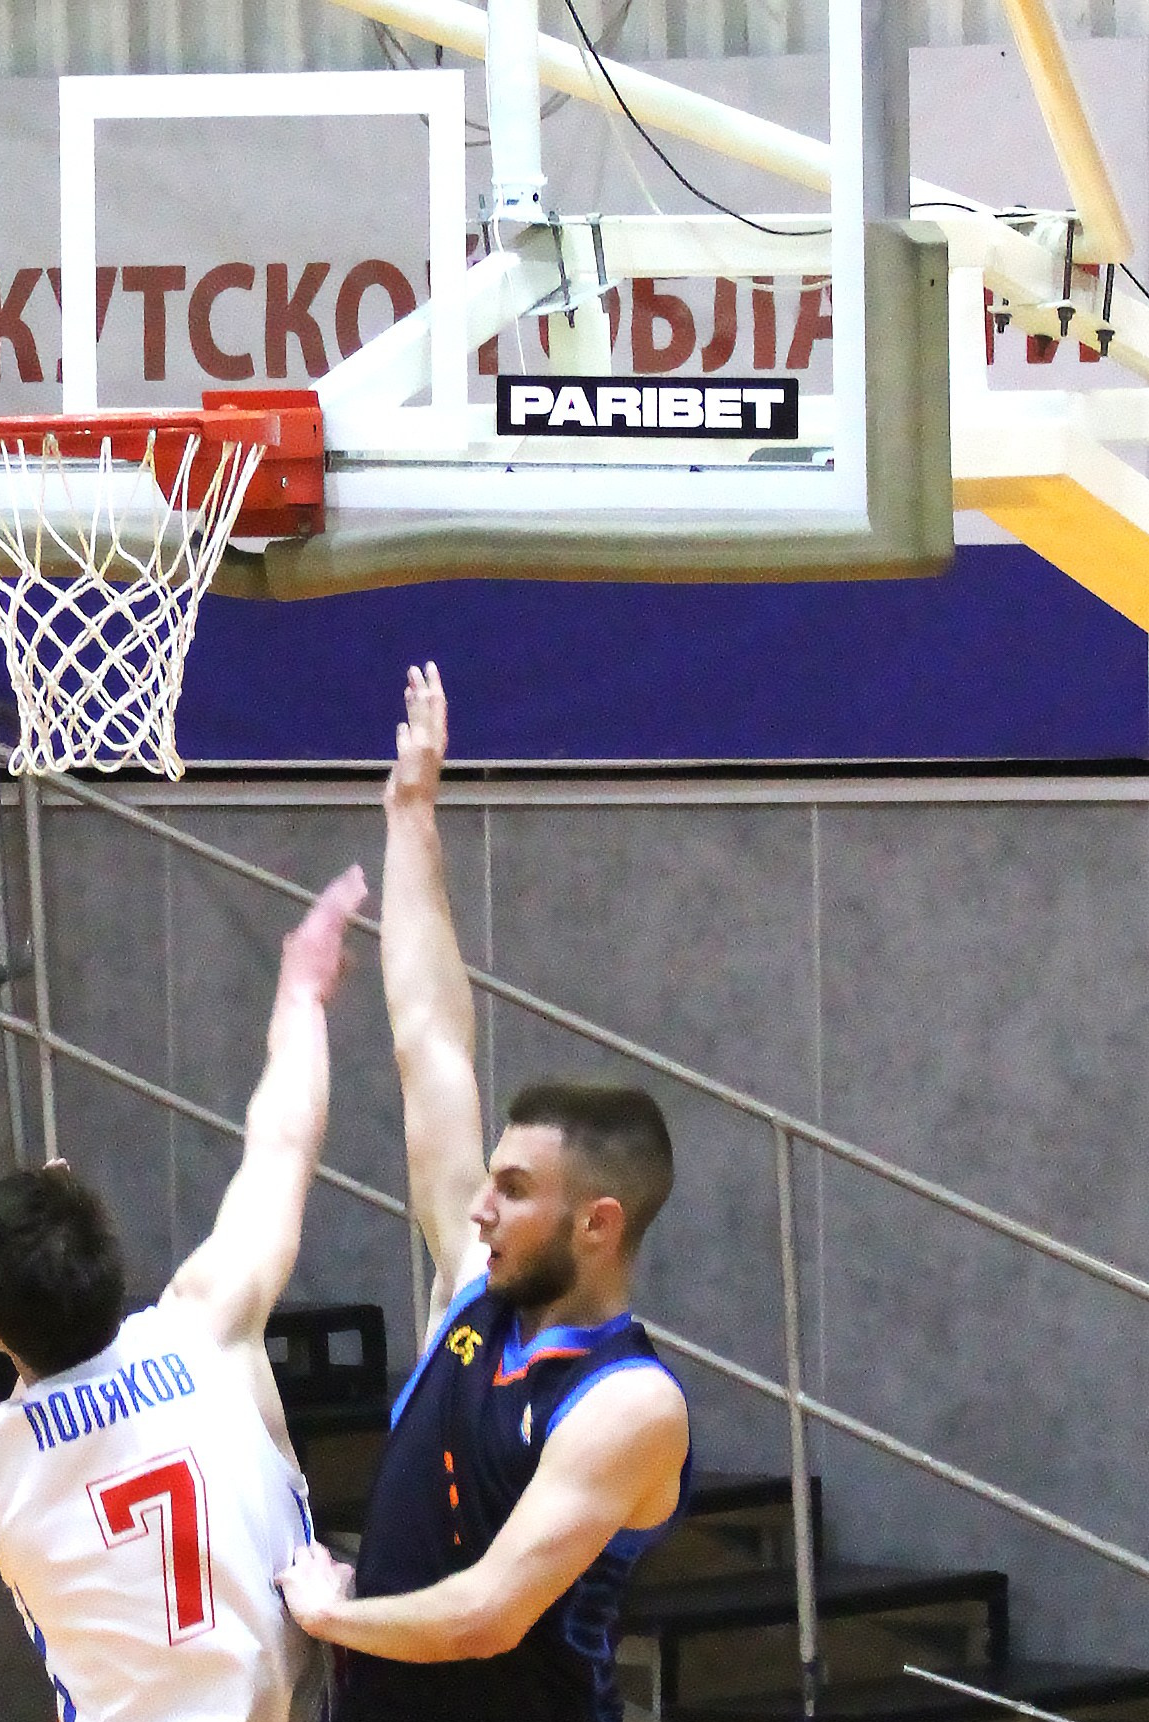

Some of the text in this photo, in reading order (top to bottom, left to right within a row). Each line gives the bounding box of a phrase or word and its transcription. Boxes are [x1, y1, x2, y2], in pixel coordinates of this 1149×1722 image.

[510, 385, 785, 430] PARIBET
[23, 1351, 197, 1453] ПОЛЯКОВ
[86, 1446, 215, 1646] 7
